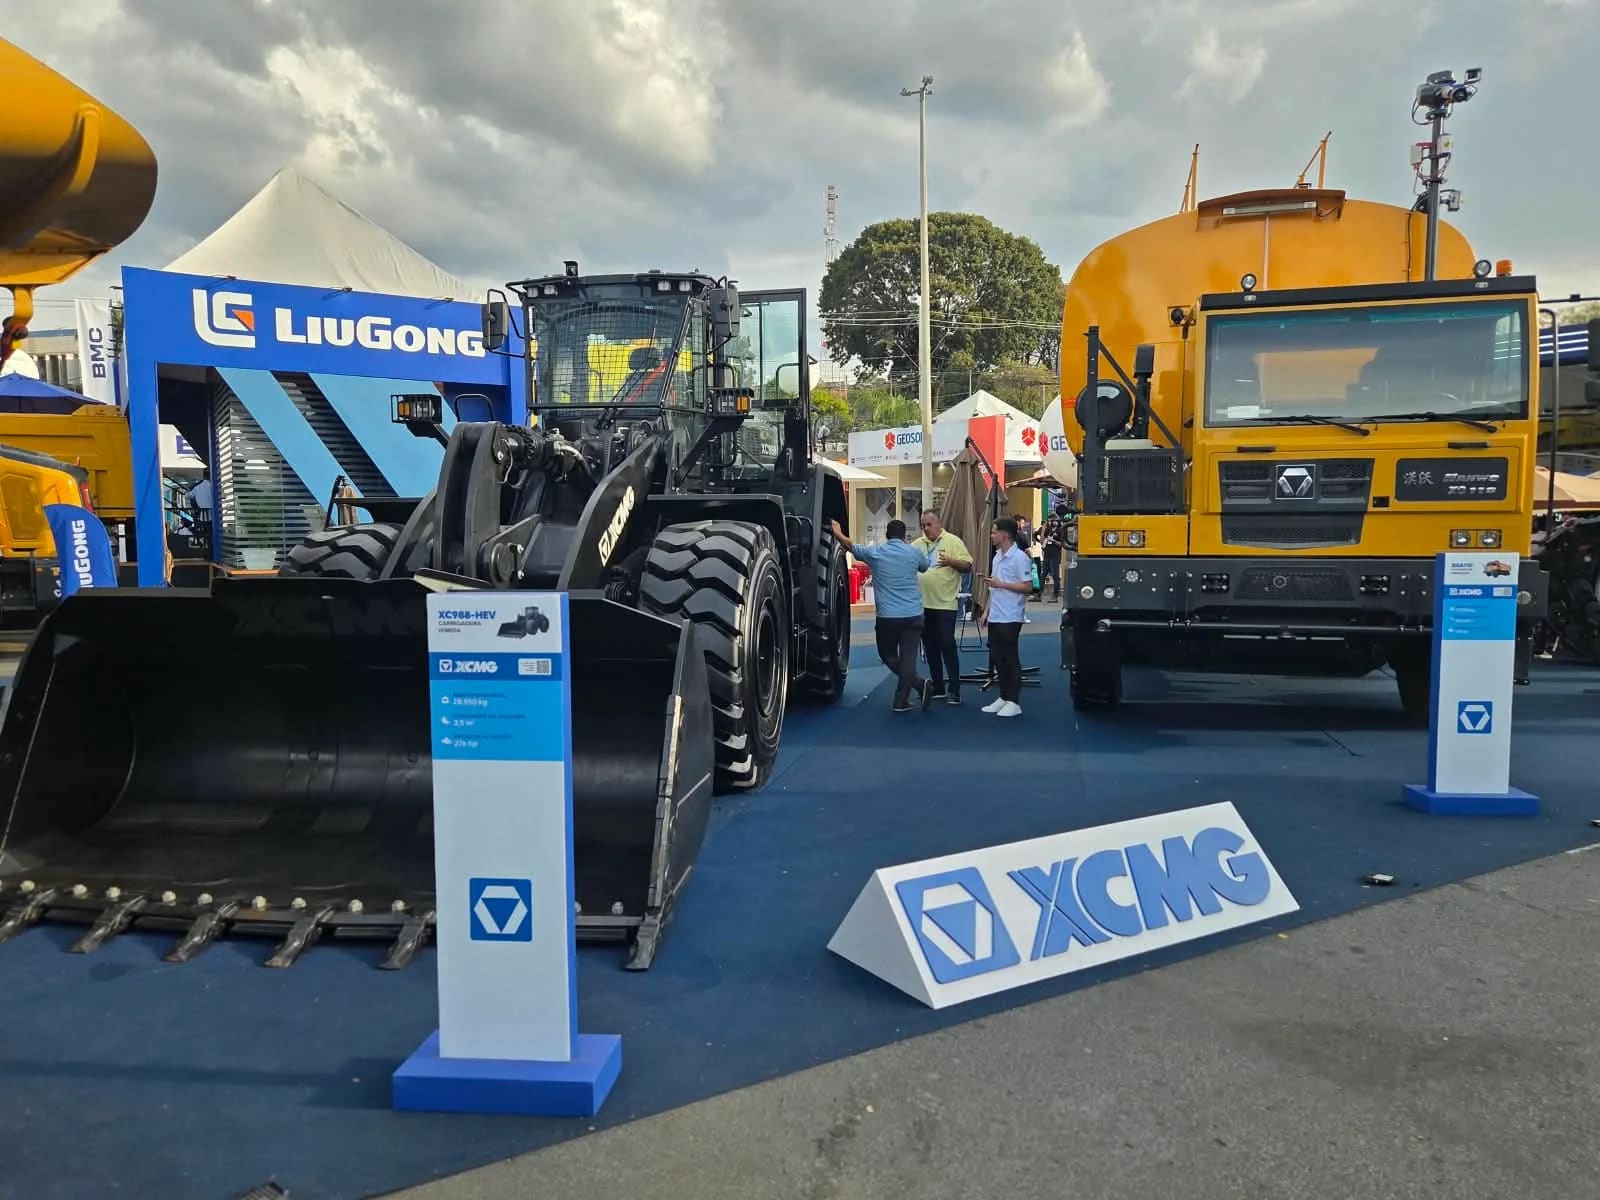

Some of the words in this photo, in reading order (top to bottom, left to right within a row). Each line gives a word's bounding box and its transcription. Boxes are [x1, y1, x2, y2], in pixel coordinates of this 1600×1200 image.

[89, 327, 106, 379] BMC
[275, 307, 486, 358] LIUGONG
[1050, 435, 1068, 452] GE
[71, 520, 95, 588] IUGONG
[438, 610, 496, 620] XC988-HEV
[453, 660, 498, 673] XCMG
[1006, 827, 1271, 962] XCMG
